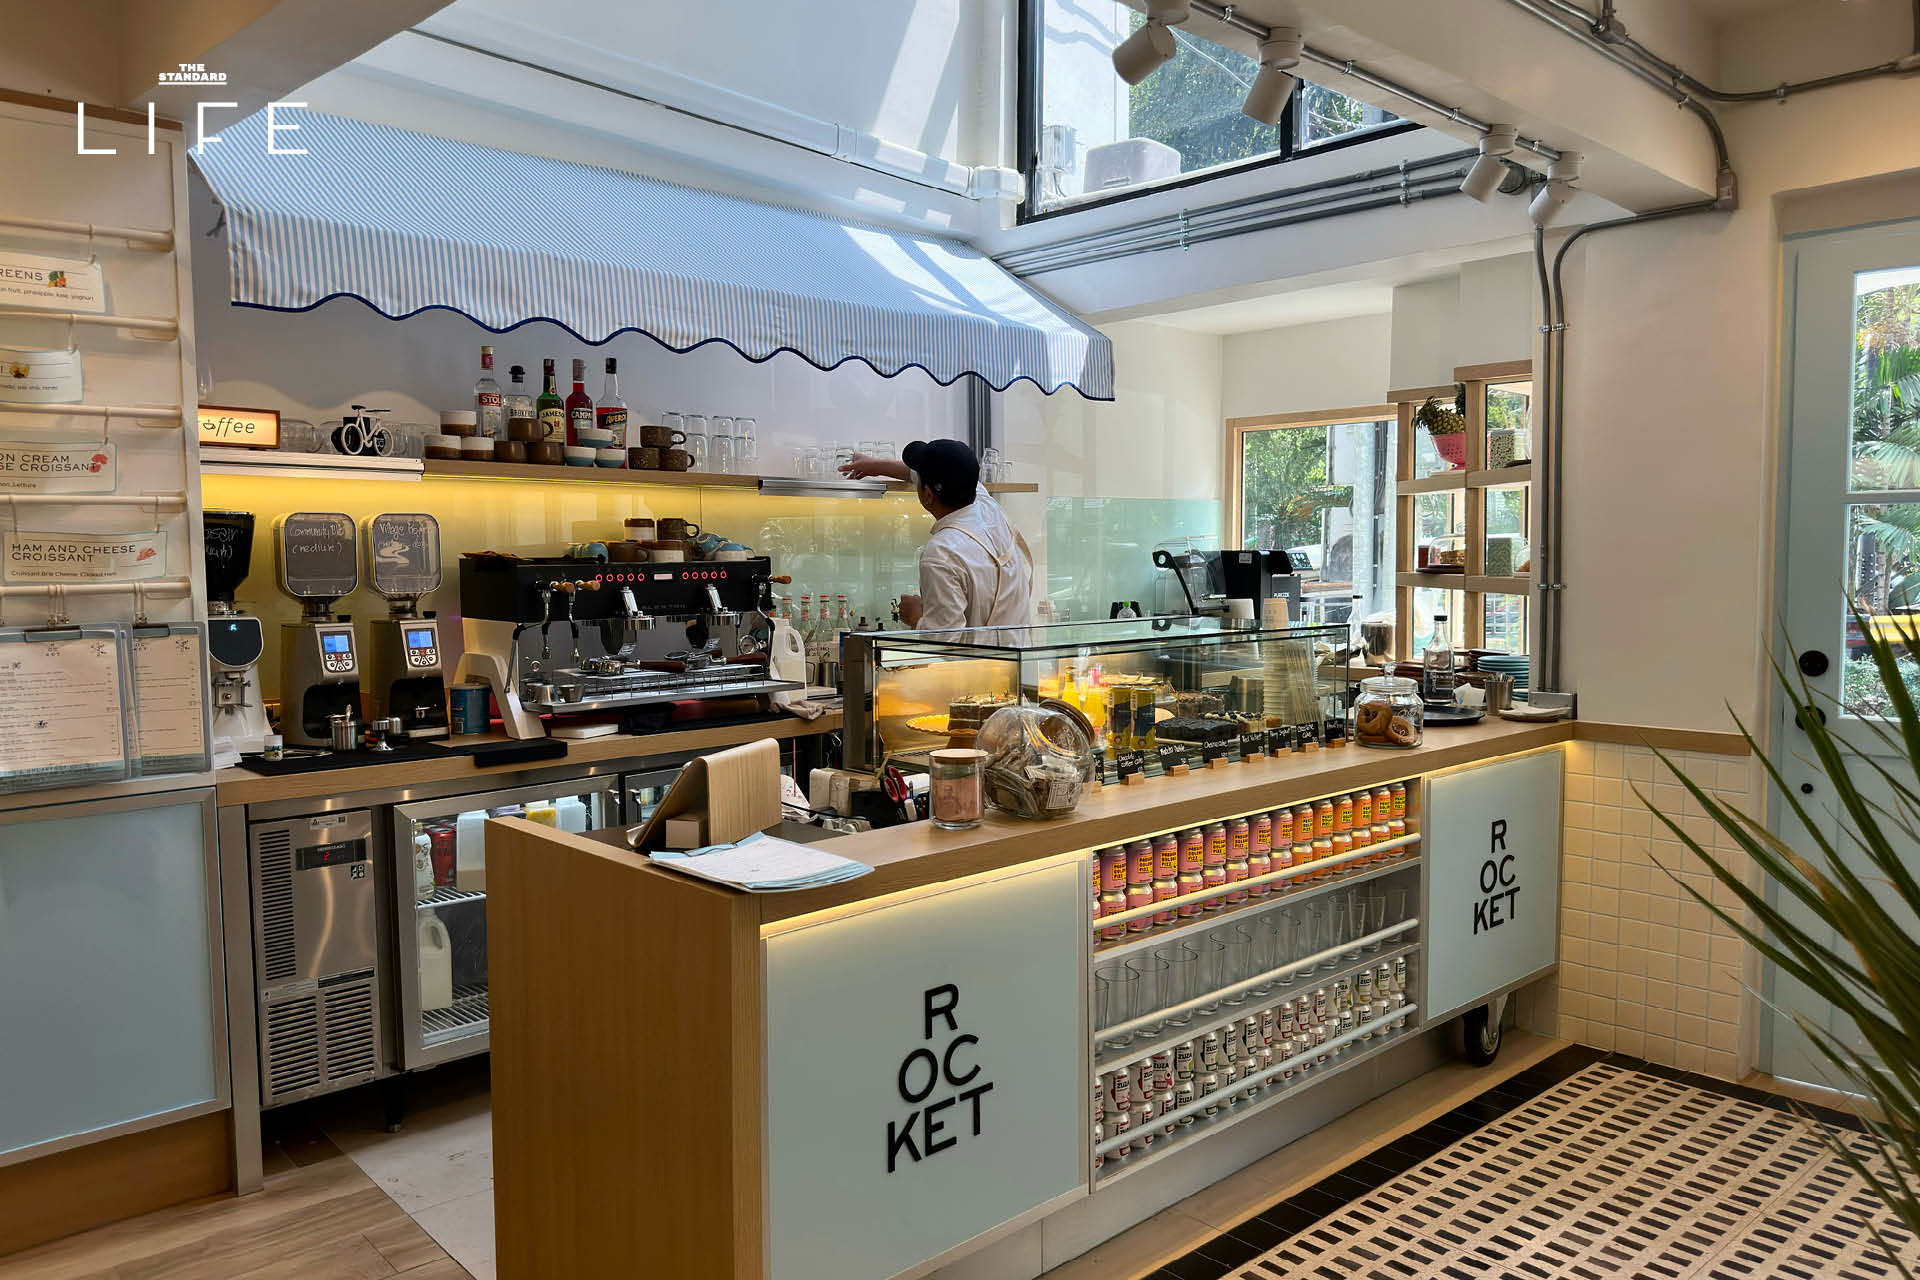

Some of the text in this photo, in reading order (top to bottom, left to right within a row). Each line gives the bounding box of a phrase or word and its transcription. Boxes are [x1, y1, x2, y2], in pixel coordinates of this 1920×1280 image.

[20, 463, 97, 472] CROISSANT
[21, 455, 70, 464] CREAM
[12, 543, 136, 554] HAM AND CHEESE
[12, 552, 94, 562] CROISSANT
[1491, 819, 1507, 853] R
[1480, 854, 1516, 894] OC
[1473, 886, 1520, 935] KET
[924, 983, 960, 1040] R
[898, 1034, 981, 1103] OC
[887, 1082, 993, 1173] KET
